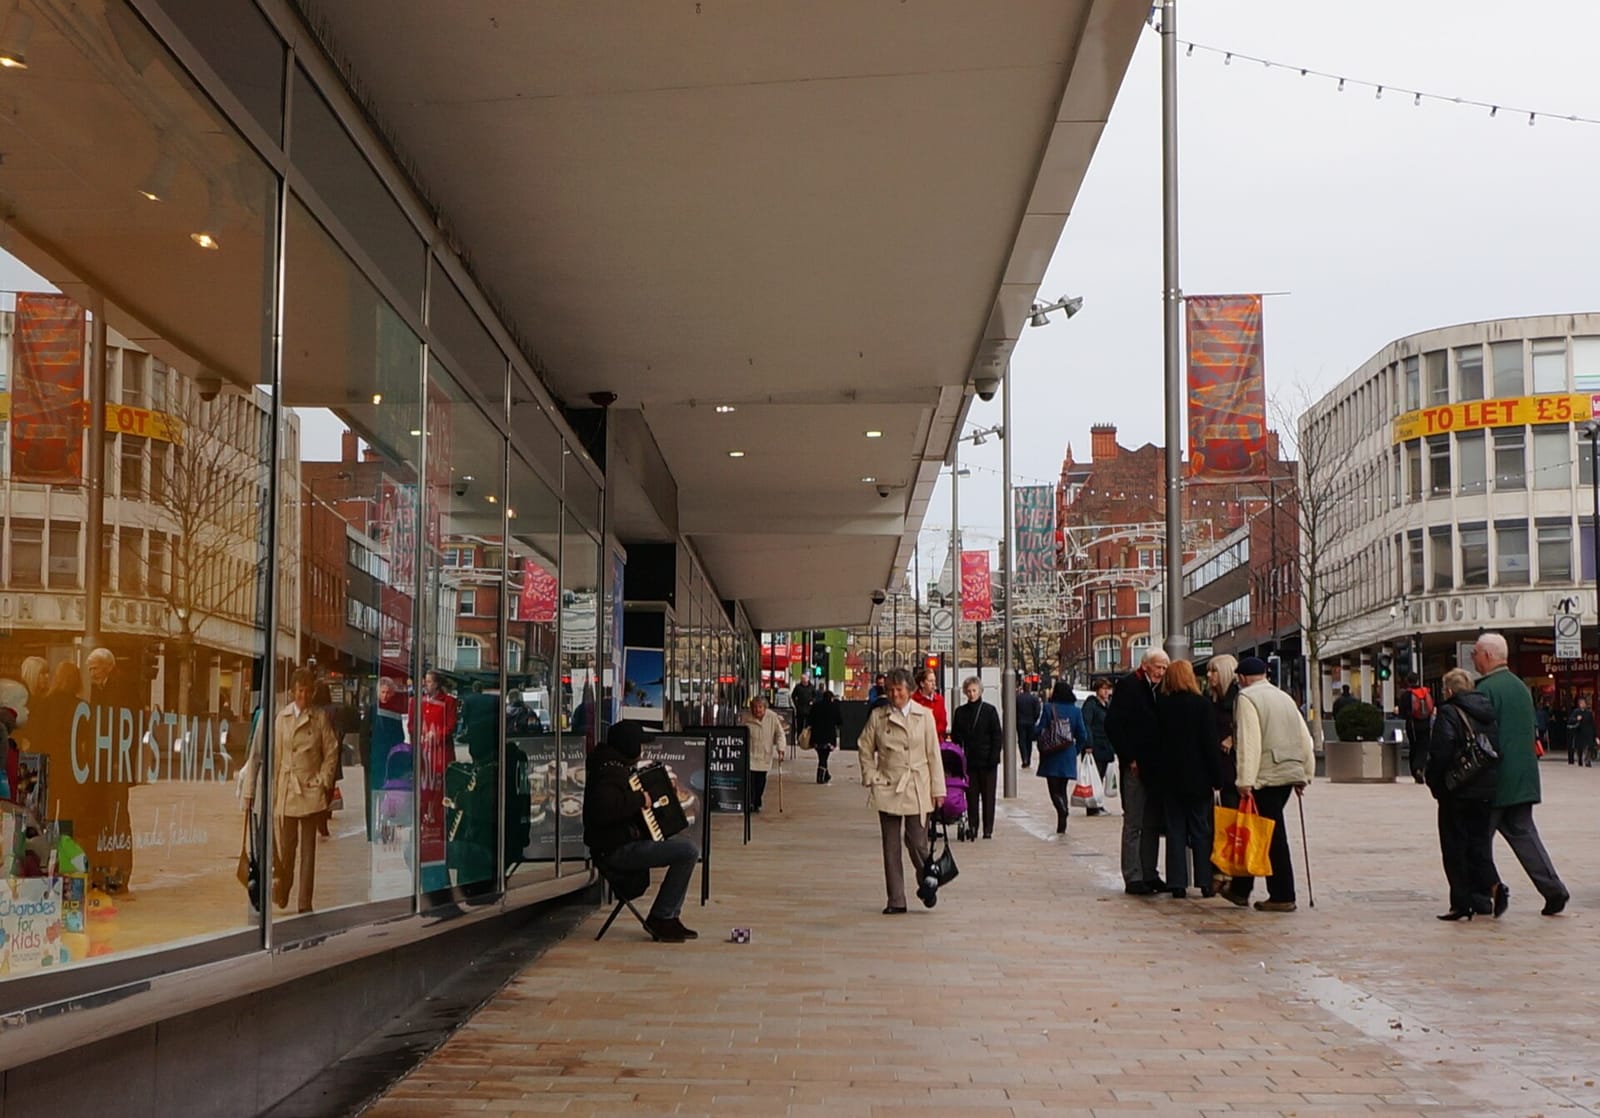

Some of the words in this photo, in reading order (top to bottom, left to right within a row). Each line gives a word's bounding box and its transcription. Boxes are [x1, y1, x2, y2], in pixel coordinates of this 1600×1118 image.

[1423, 410, 1453, 433] TO
[1464, 400, 1519, 427] LET
[1537, 397, 1571, 420] £5
[1411, 595, 1520, 624] MIDCITY
[70, 701, 230, 785] CHRISTMAS
[716, 735, 744, 746] rates
[640, 750, 686, 761] Christmas
[727, 746, 741, 759] be
[0, 898, 57, 917] Charades
[18, 917, 34, 933] for
[11, 931, 41, 952] Kids
